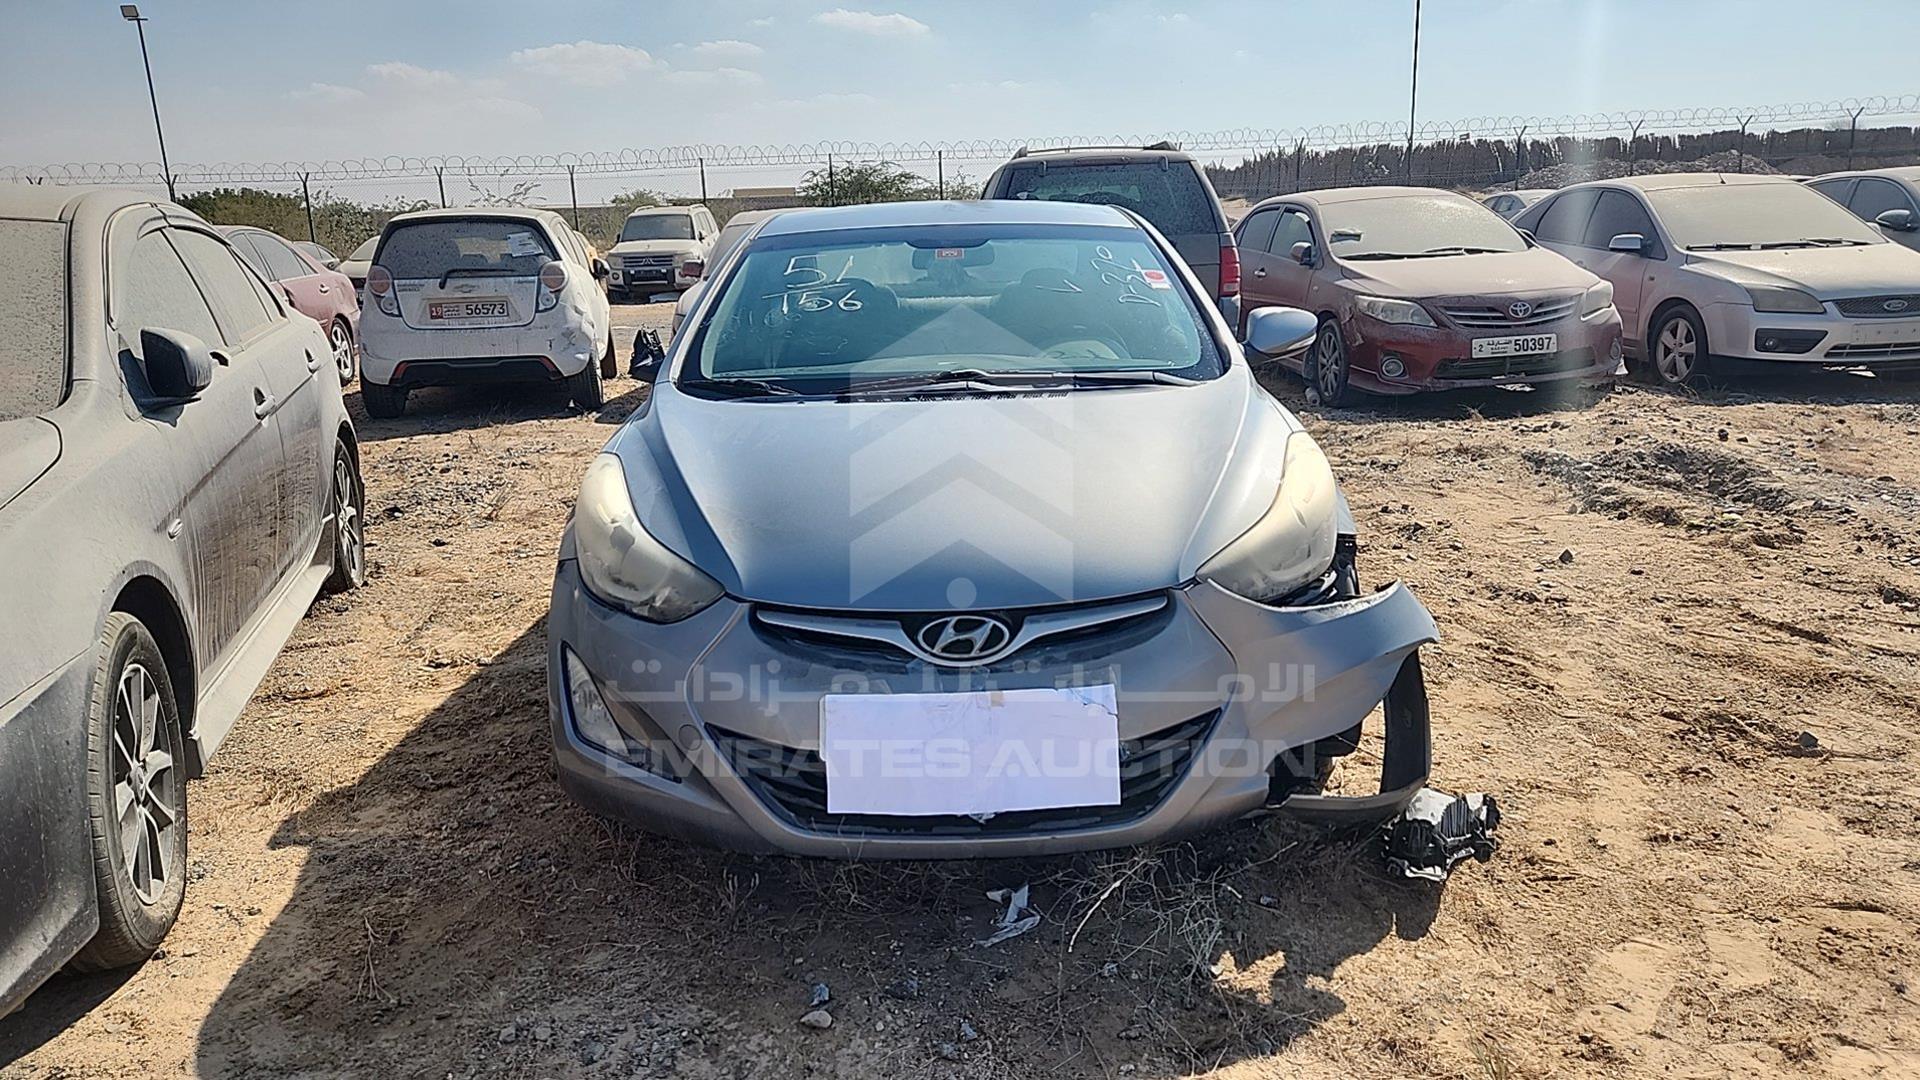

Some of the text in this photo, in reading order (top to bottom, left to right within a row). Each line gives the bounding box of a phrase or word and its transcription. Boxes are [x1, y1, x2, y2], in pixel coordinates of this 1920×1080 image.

[465, 303, 505, 316] 56573
[1478, 344, 1484, 352] 2
[1514, 337, 1552, 352] 50397
